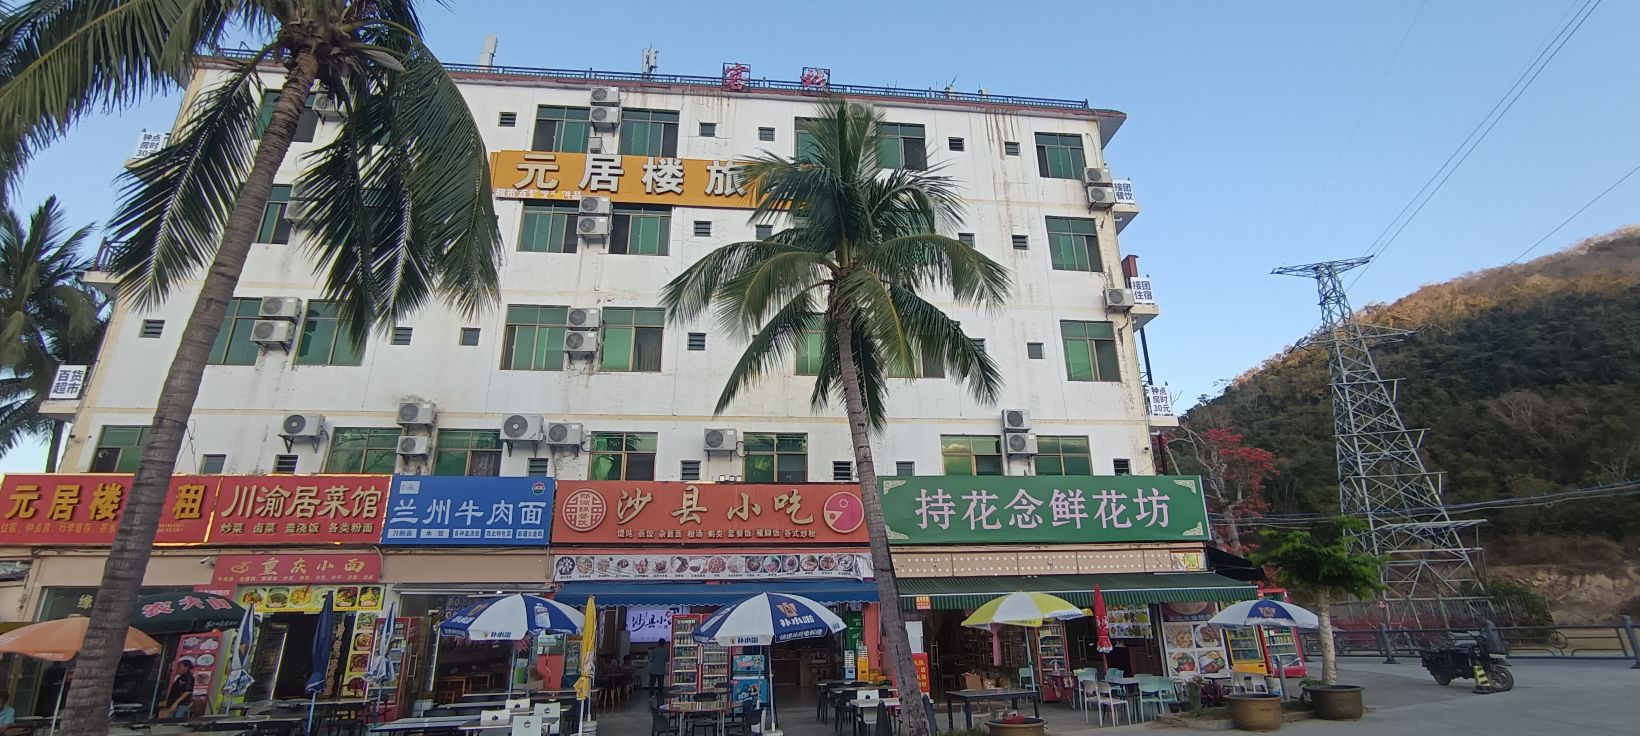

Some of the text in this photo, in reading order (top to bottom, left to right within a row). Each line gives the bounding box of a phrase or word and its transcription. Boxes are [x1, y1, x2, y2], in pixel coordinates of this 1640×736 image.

[143, 133, 161, 142] 钟点
[1114, 182, 1132, 192] 接团
[1115, 191, 1133, 200] 餐饮
[1132, 281, 1151, 290] 接团
[1134, 291, 1152, 300] 住宿
[58, 370, 84, 382] 百货
[52, 382, 80, 394] 超市
[1153, 404, 1170, 412] 30元
[220, 484, 382, 519] 川渝居菜馆
[617, 485, 814, 526] 沙县小吃
[390, 498, 547, 526] 兰州牛肉面
[915, 487, 1171, 530] 持花念鲜花坊
[221, 522, 374, 534] 炒菜 卤菜 盖浇饭 各类粉面
[258, 557, 365, 575] 重庆小面
[779, 615, 815, 627] 补水啦
